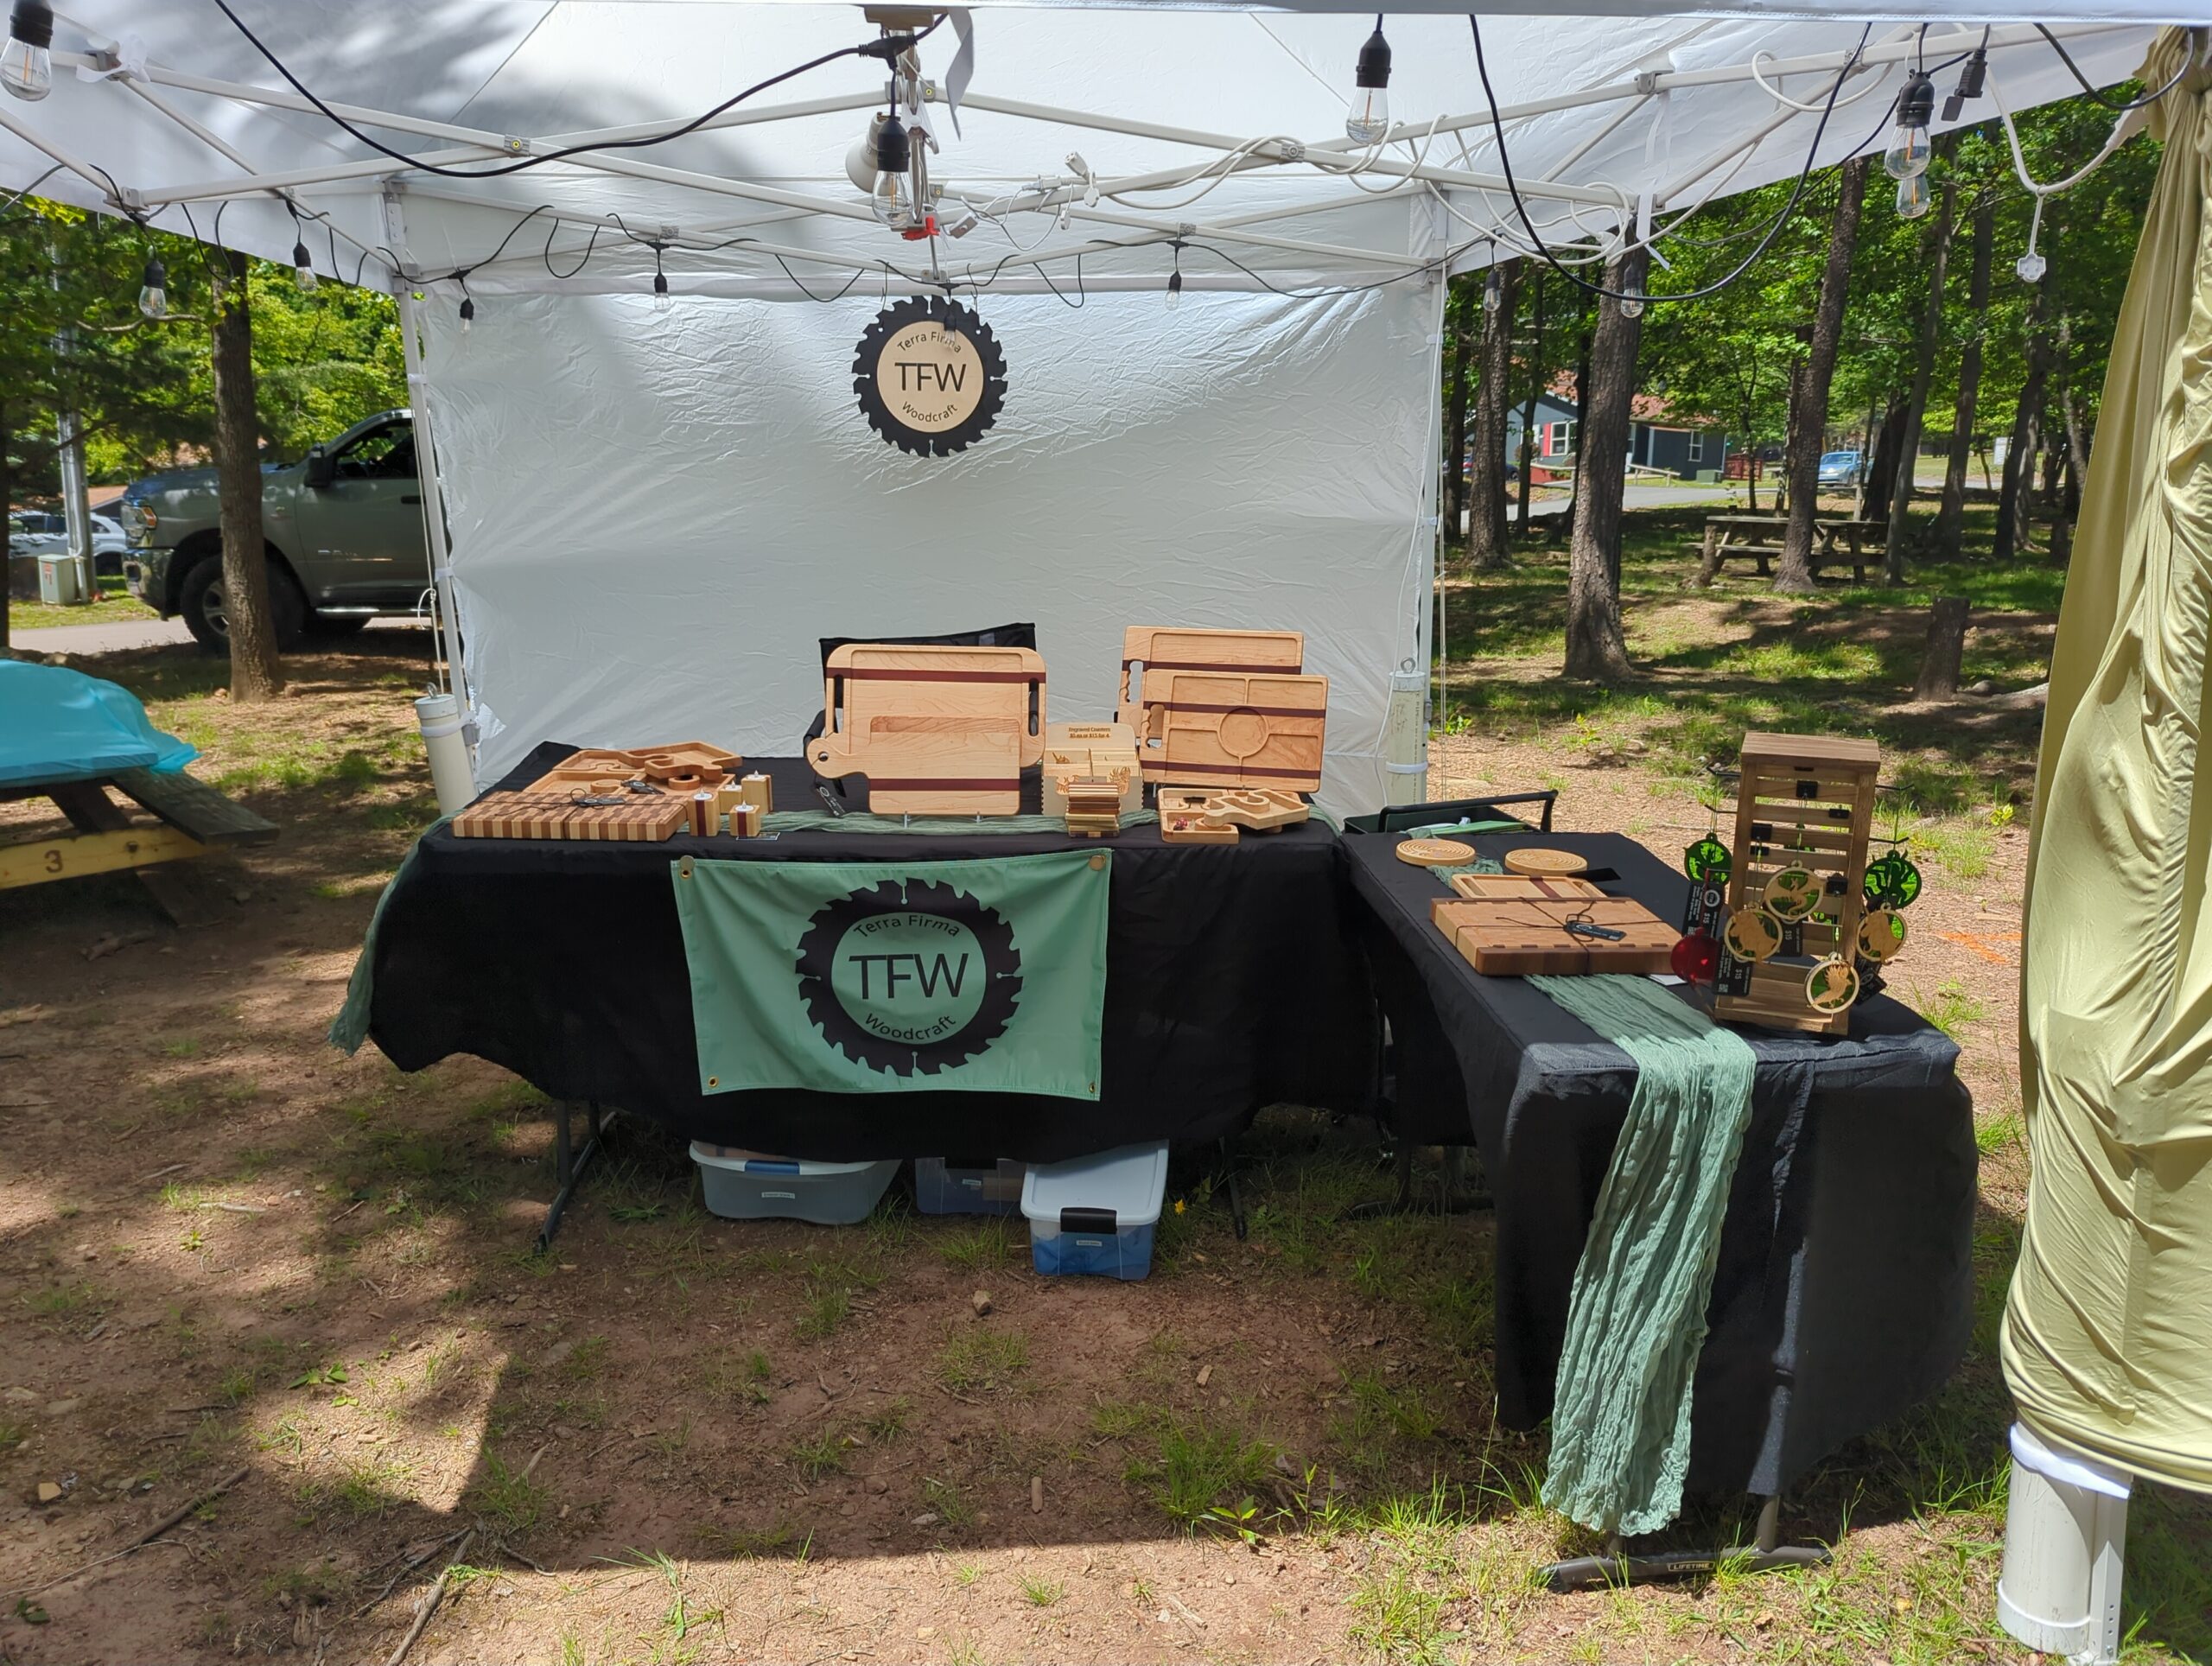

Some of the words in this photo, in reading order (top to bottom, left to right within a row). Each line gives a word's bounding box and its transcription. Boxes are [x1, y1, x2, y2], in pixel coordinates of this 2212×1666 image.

[897, 334, 927, 352] Terra
[894, 362, 967, 392] TFW
[902, 401, 958, 423] Woodcraft
[44, 849, 63, 873] 3
[853, 917, 901, 938] Terra
[908, 914, 960, 937] Firma
[849, 952, 969, 1000] TFW
[865, 1013, 957, 1040] Woodcraft
